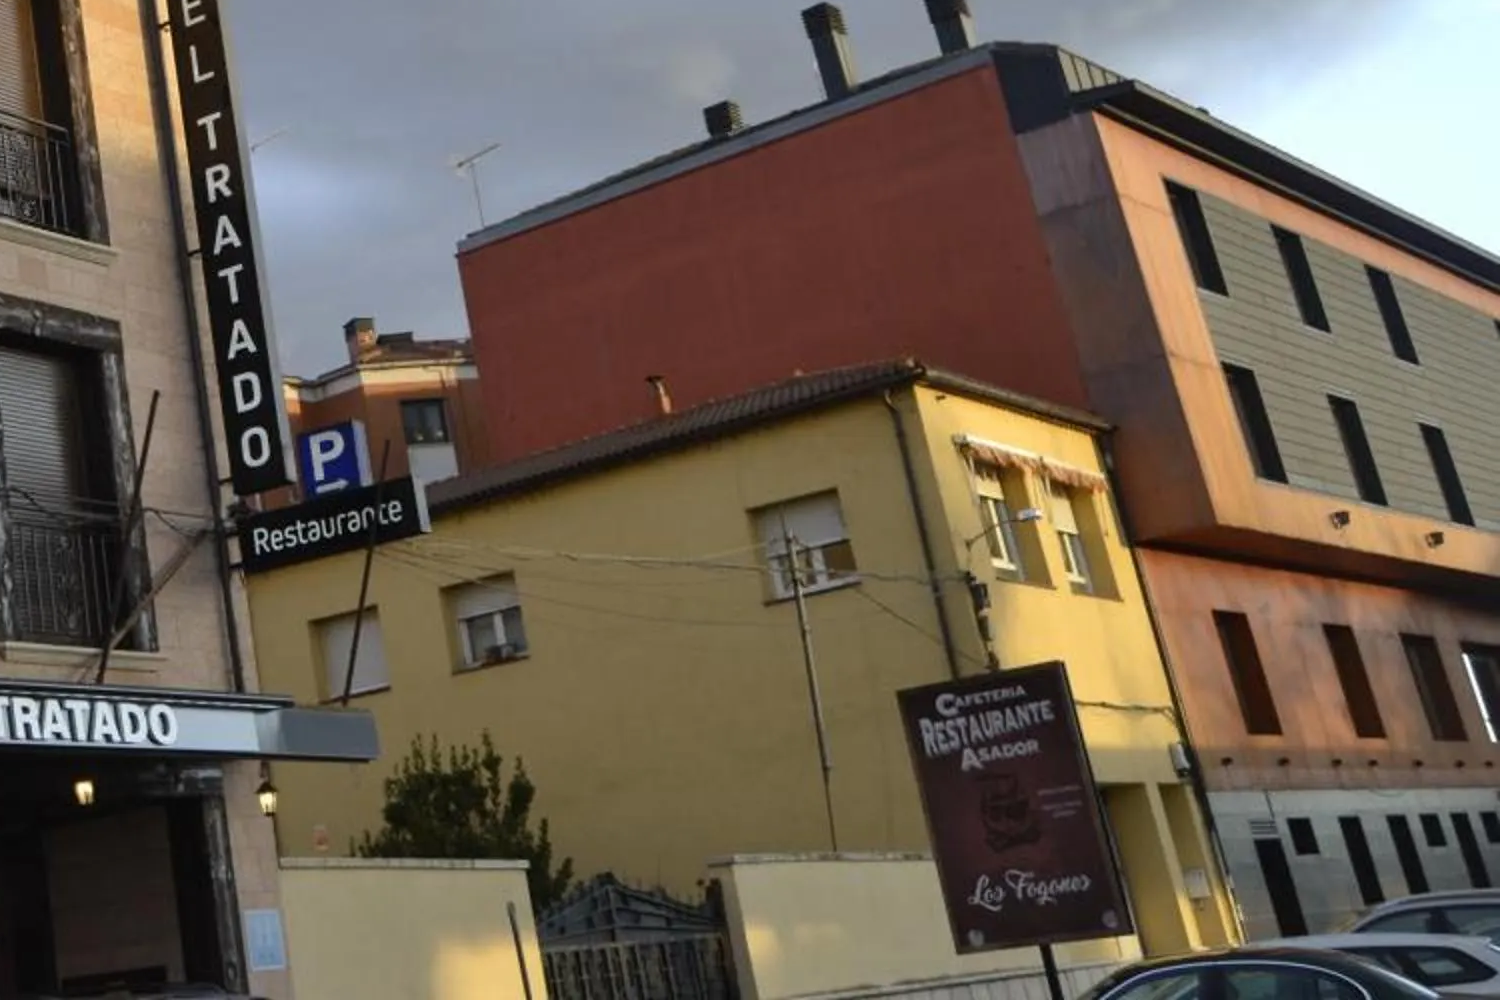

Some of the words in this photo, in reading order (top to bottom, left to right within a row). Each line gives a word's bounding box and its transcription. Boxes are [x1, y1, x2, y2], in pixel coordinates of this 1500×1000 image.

[196, 111, 272, 469] TRATADO
[308, 430, 345, 481] P
[919, 699, 1056, 757] RESTAURANTE
[961, 739, 1040, 771] ASADOR
